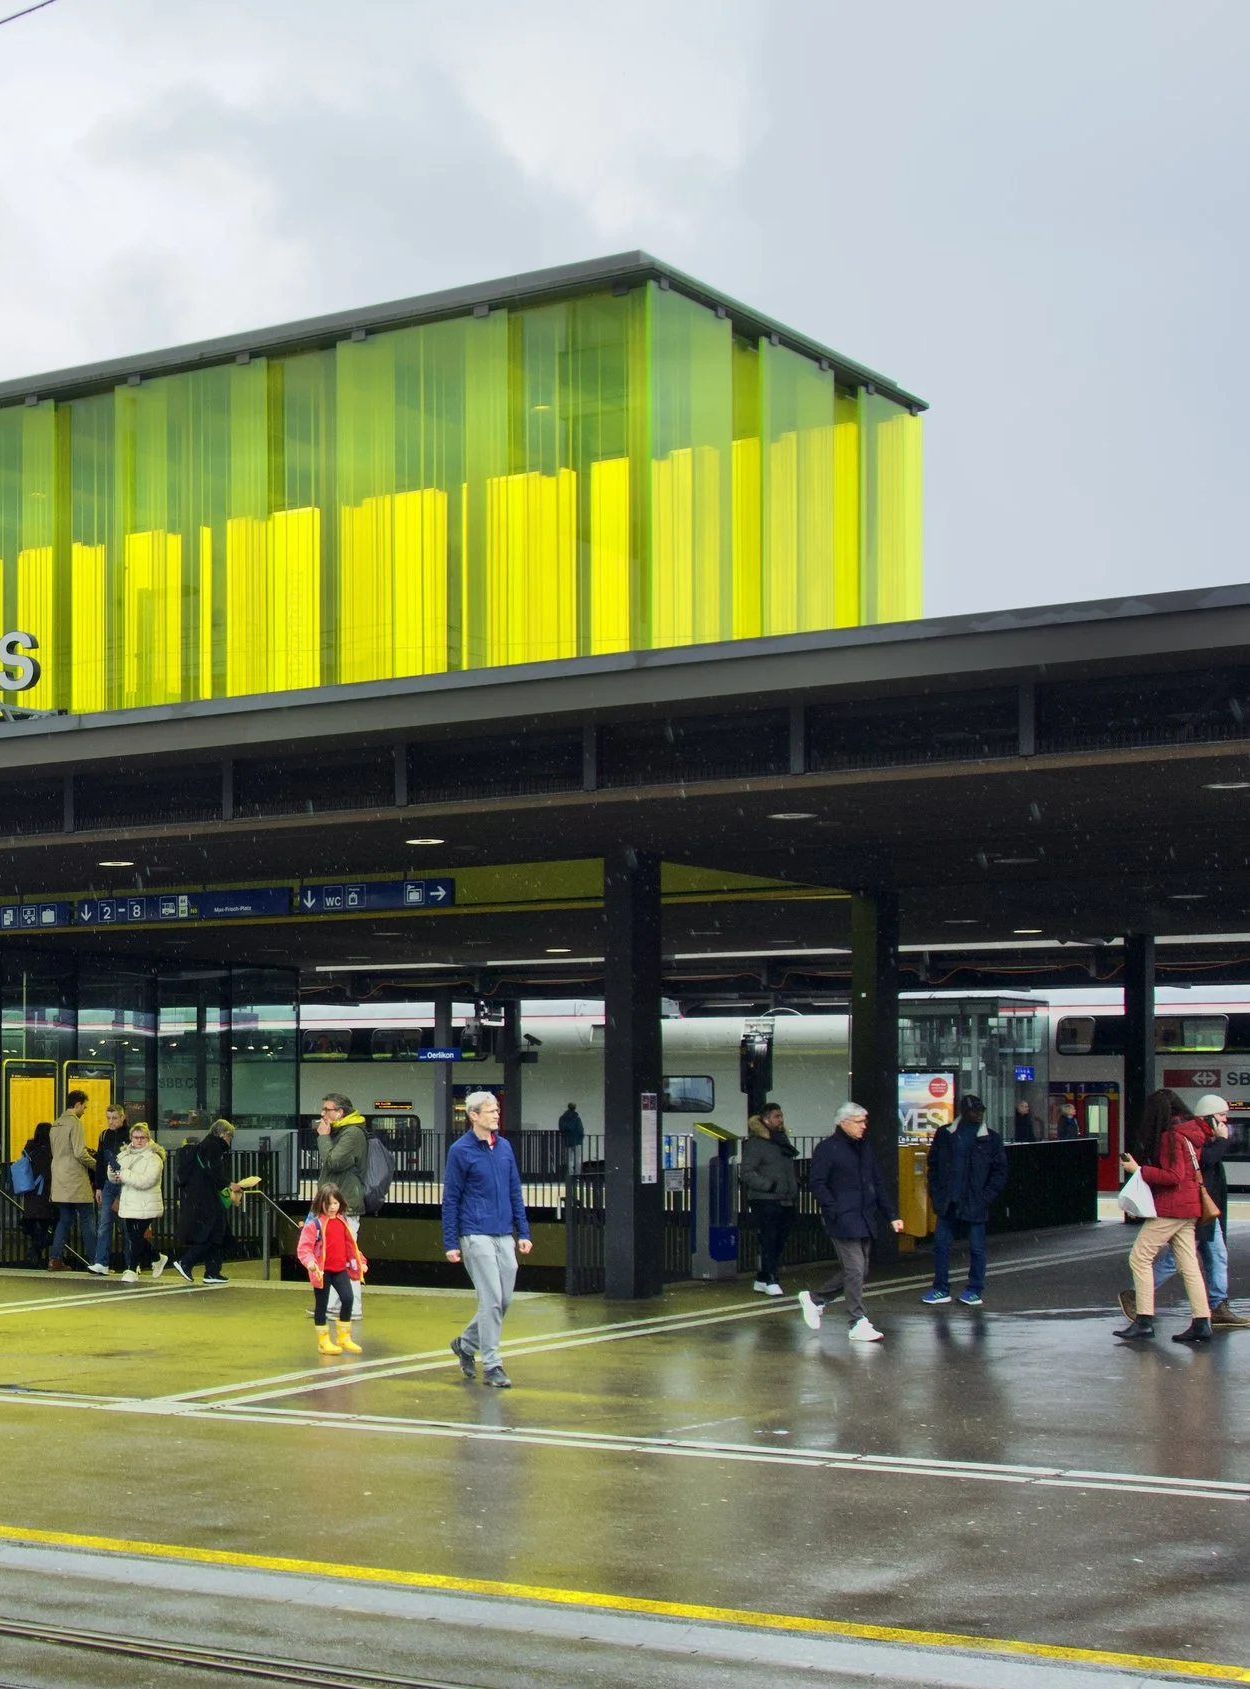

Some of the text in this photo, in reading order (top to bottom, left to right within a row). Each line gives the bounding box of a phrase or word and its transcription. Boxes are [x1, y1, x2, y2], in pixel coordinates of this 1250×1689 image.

[326, 897, 341, 906] WC
[103, 907, 111, 919] 2
[133, 905, 141, 917] 8
[426, 1051, 455, 1059] Oerlikon
